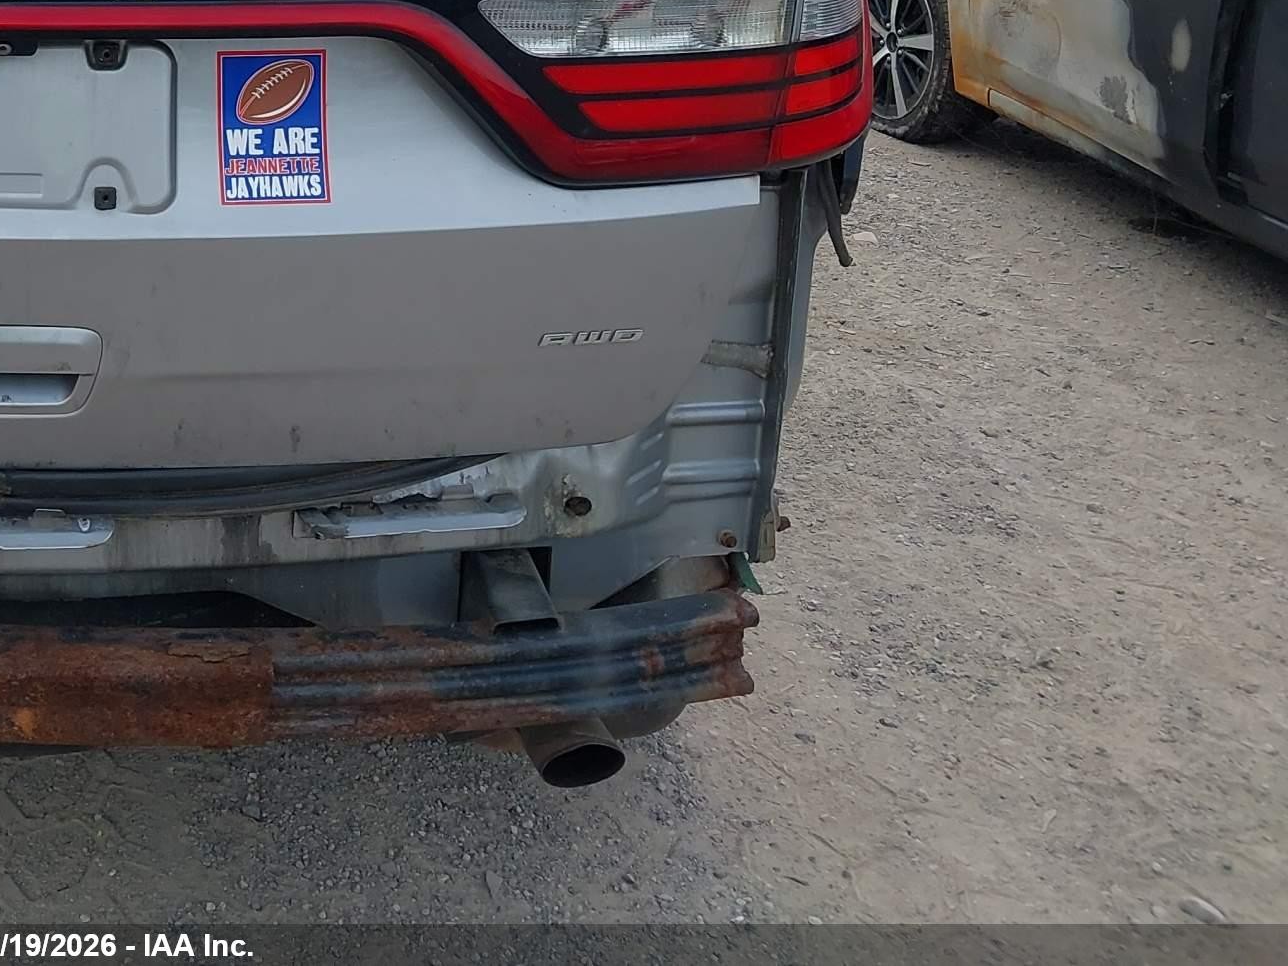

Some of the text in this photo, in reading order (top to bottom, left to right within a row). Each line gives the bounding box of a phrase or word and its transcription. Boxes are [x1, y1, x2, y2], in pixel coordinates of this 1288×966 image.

[225, 127, 321, 155] WE ARE
[224, 156, 321, 176] JEANNETTE
[226, 175, 322, 199] JAYHAWKS
[537, 328, 644, 347] AWD
